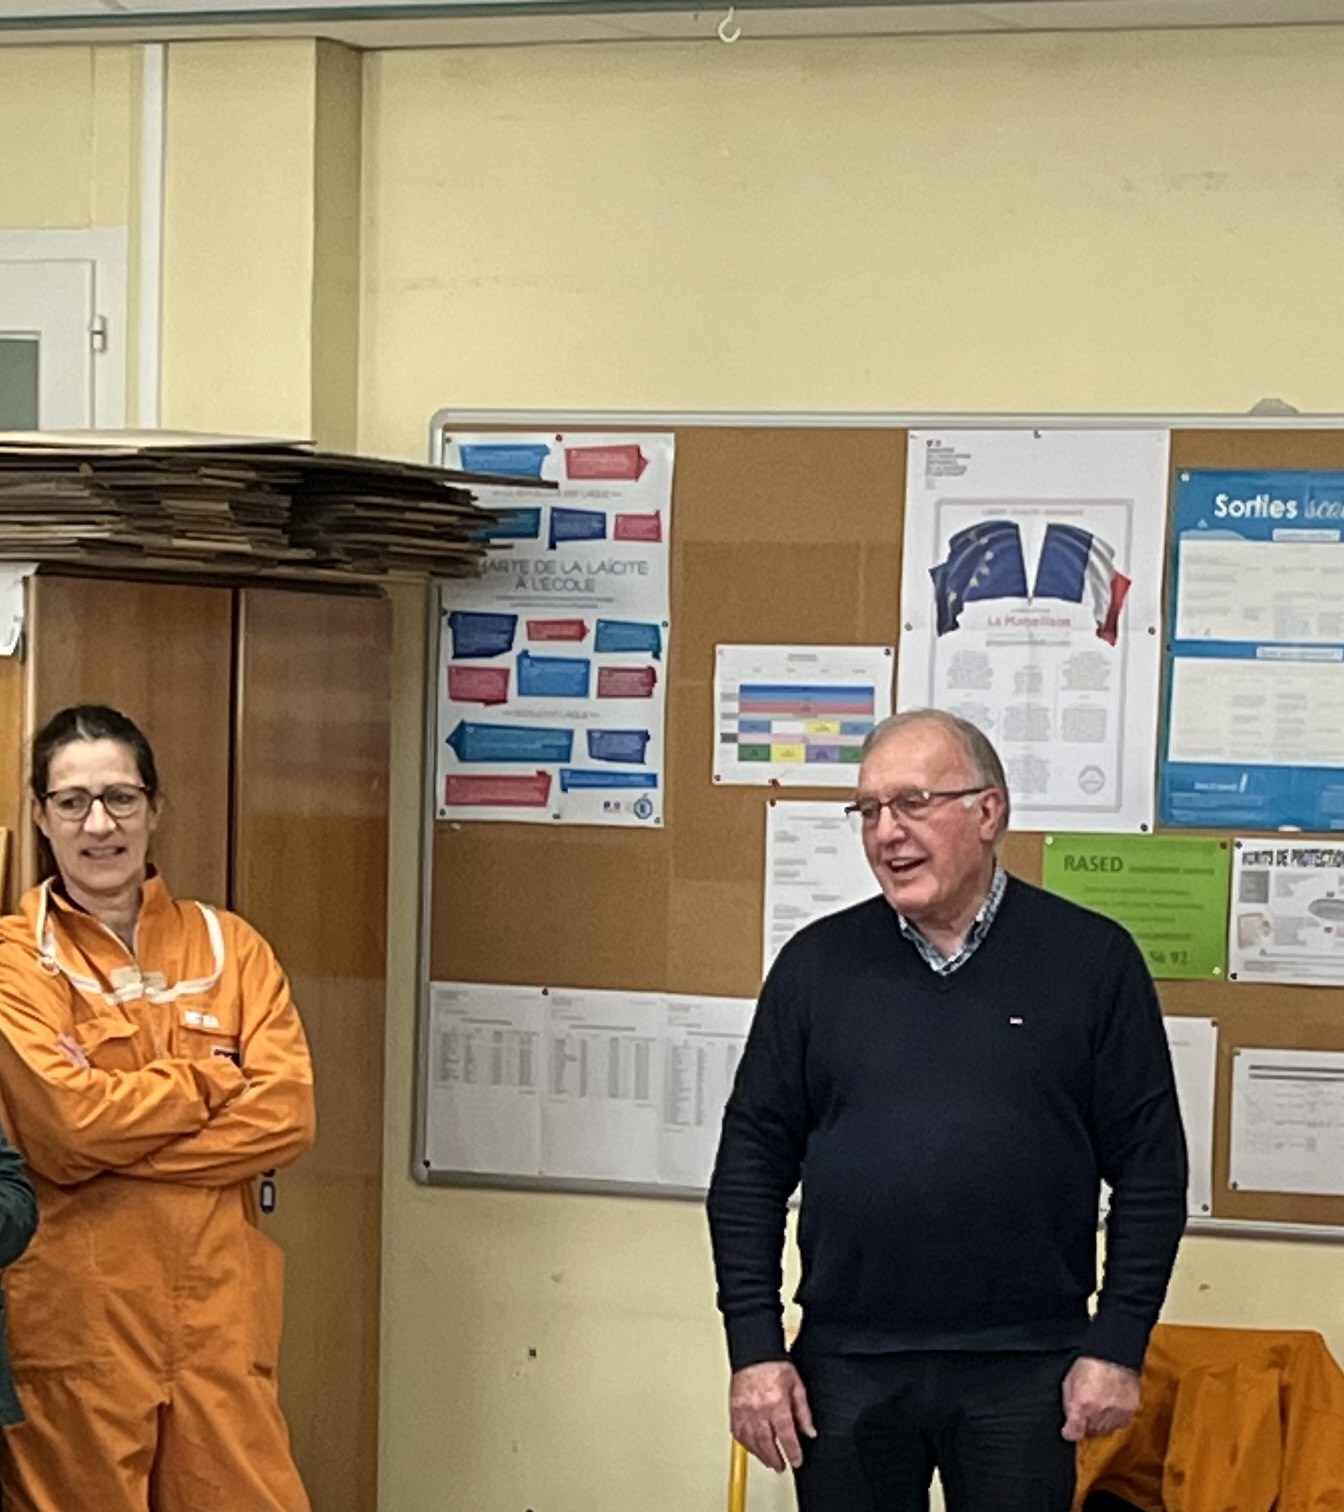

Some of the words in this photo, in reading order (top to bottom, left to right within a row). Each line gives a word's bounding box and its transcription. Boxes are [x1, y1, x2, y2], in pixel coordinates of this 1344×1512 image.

[1214, 494, 1297, 518] Sorties
[533, 559, 555, 575] DE
[560, 559, 583, 575] LA
[1063, 854, 1124, 874] RASED
